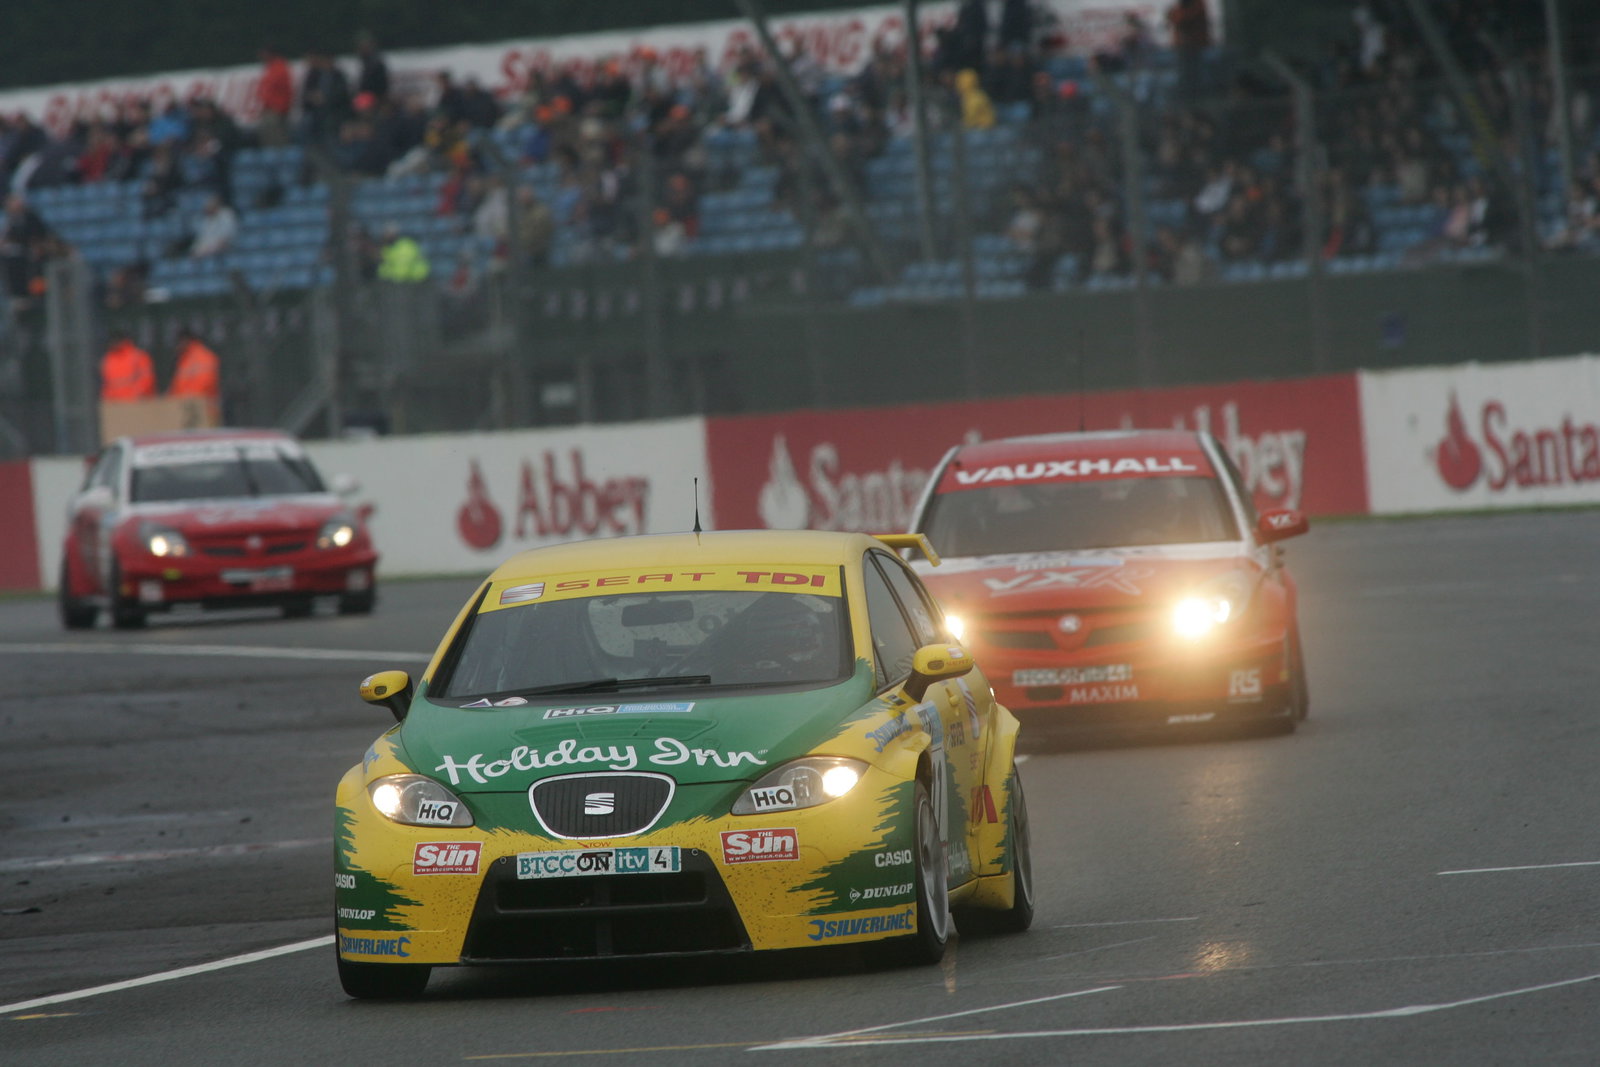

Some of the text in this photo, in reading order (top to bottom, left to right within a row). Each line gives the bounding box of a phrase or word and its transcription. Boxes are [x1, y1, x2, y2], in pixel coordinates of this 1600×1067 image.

[955, 457, 1197, 485] VAUXHALL
[515, 449, 651, 539] Abbey
[555, 571, 826, 592] SEAT TDI
[1229, 668, 1261, 696] RS
[1070, 685, 1139, 703] MAXIM
[435, 737, 768, 785] Holiday Inn
[753, 789, 794, 808] HiQ
[418, 804, 453, 822] HiQ
[725, 833, 794, 855] Sun
[415, 845, 477, 867] Sun
[618, 851, 646, 869] itv
[654, 850, 667, 869] 4
[874, 849, 913, 868] CASIO
[335, 873, 356, 889] CASIO
[862, 883, 913, 900] DUNLOP
[340, 907, 376, 920] DUNLOP
